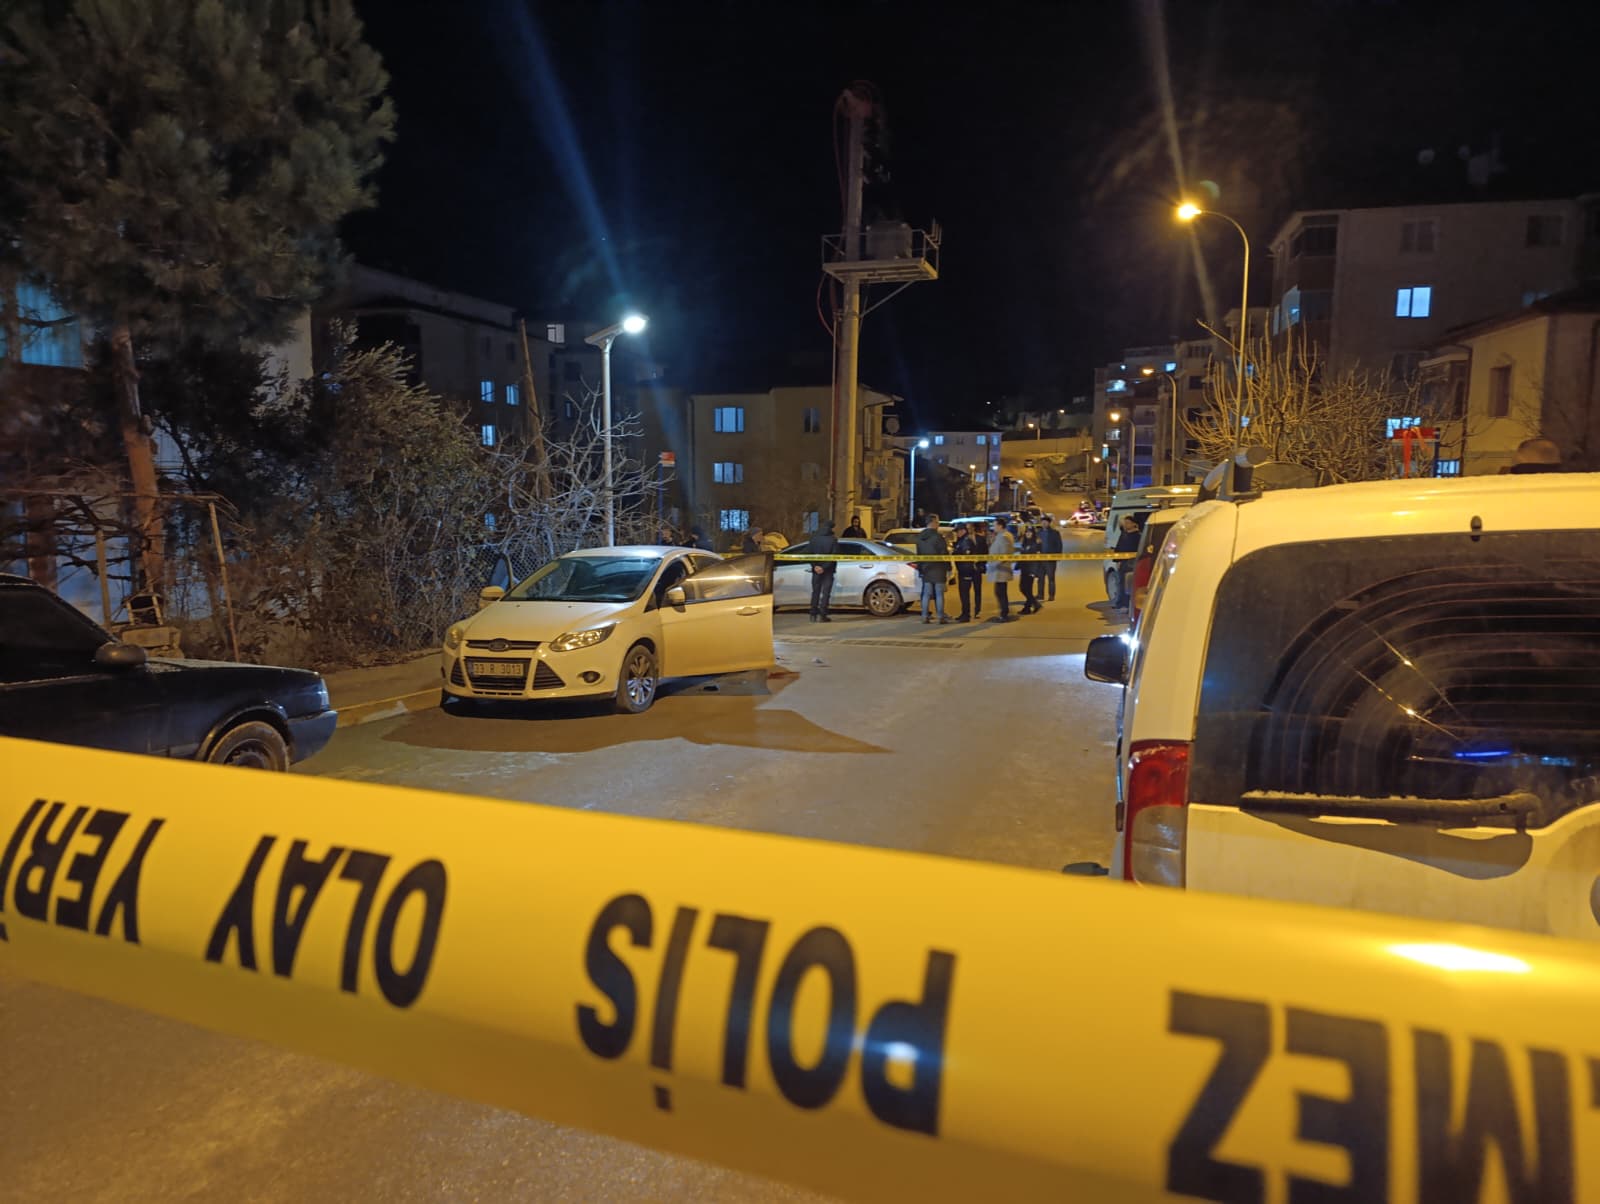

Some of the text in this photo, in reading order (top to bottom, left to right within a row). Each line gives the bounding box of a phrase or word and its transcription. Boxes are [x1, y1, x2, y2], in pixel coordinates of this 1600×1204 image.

[204, 834, 448, 1009] OLAY
[575, 893, 957, 1137] POLİS
[1166, 989, 1600, 1204] MEZ
